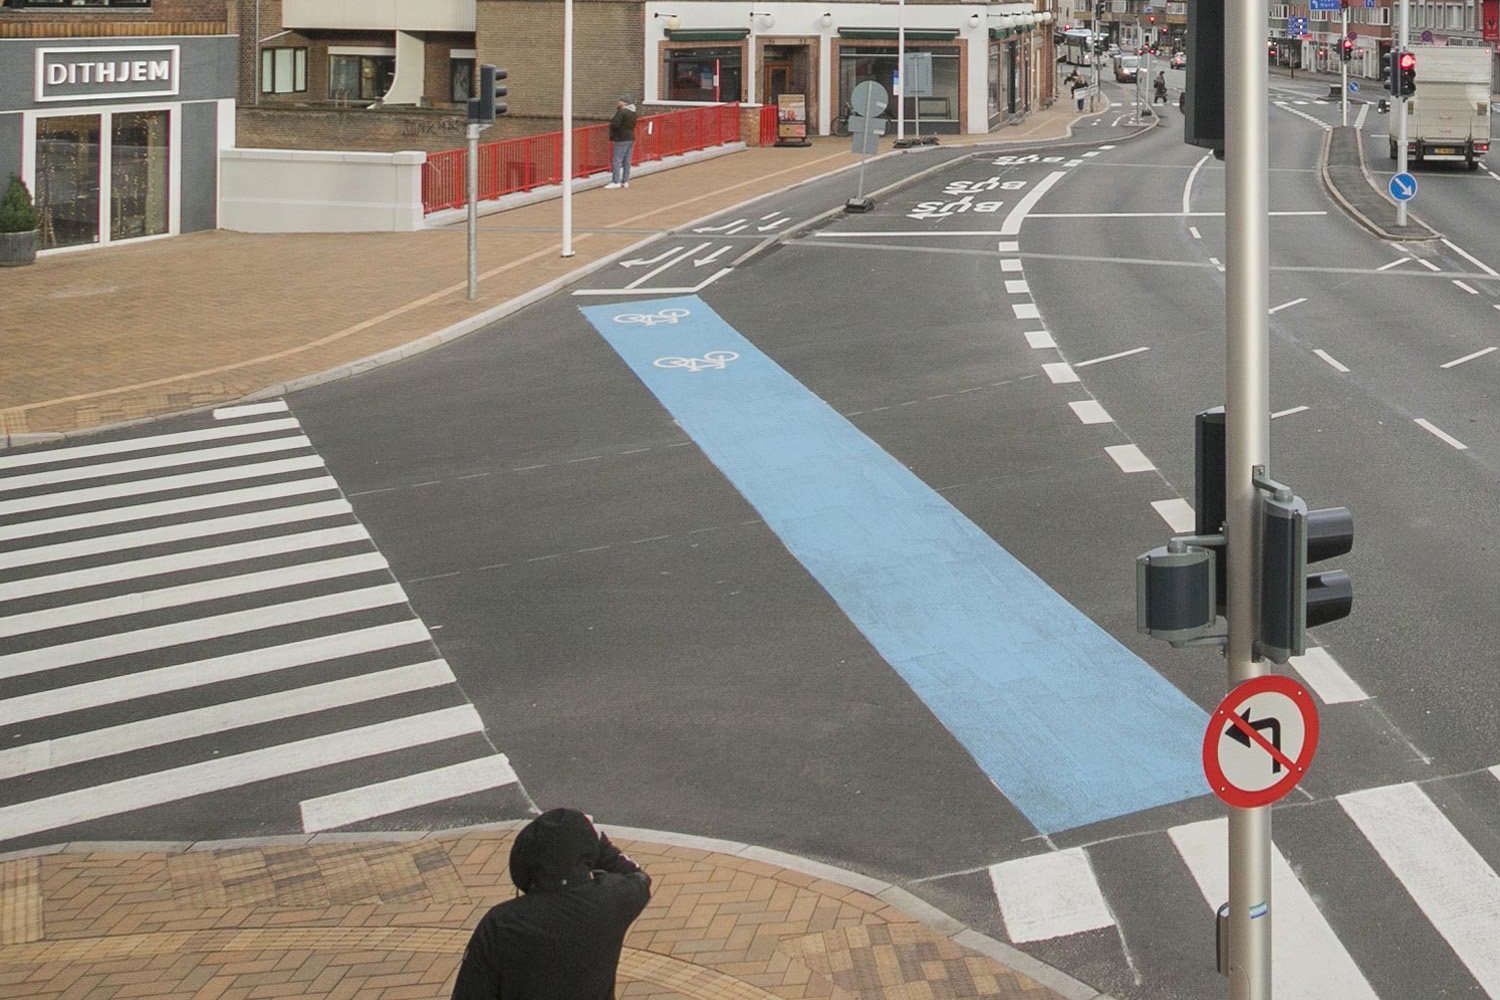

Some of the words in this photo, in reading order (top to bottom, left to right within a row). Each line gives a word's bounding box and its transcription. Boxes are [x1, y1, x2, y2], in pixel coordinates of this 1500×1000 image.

[47, 60, 169, 85] DITHJEM
[993, 154, 1065, 164] BUS
[944, 179, 1028, 191] BUS
[911, 199, 1004, 213] BUS
